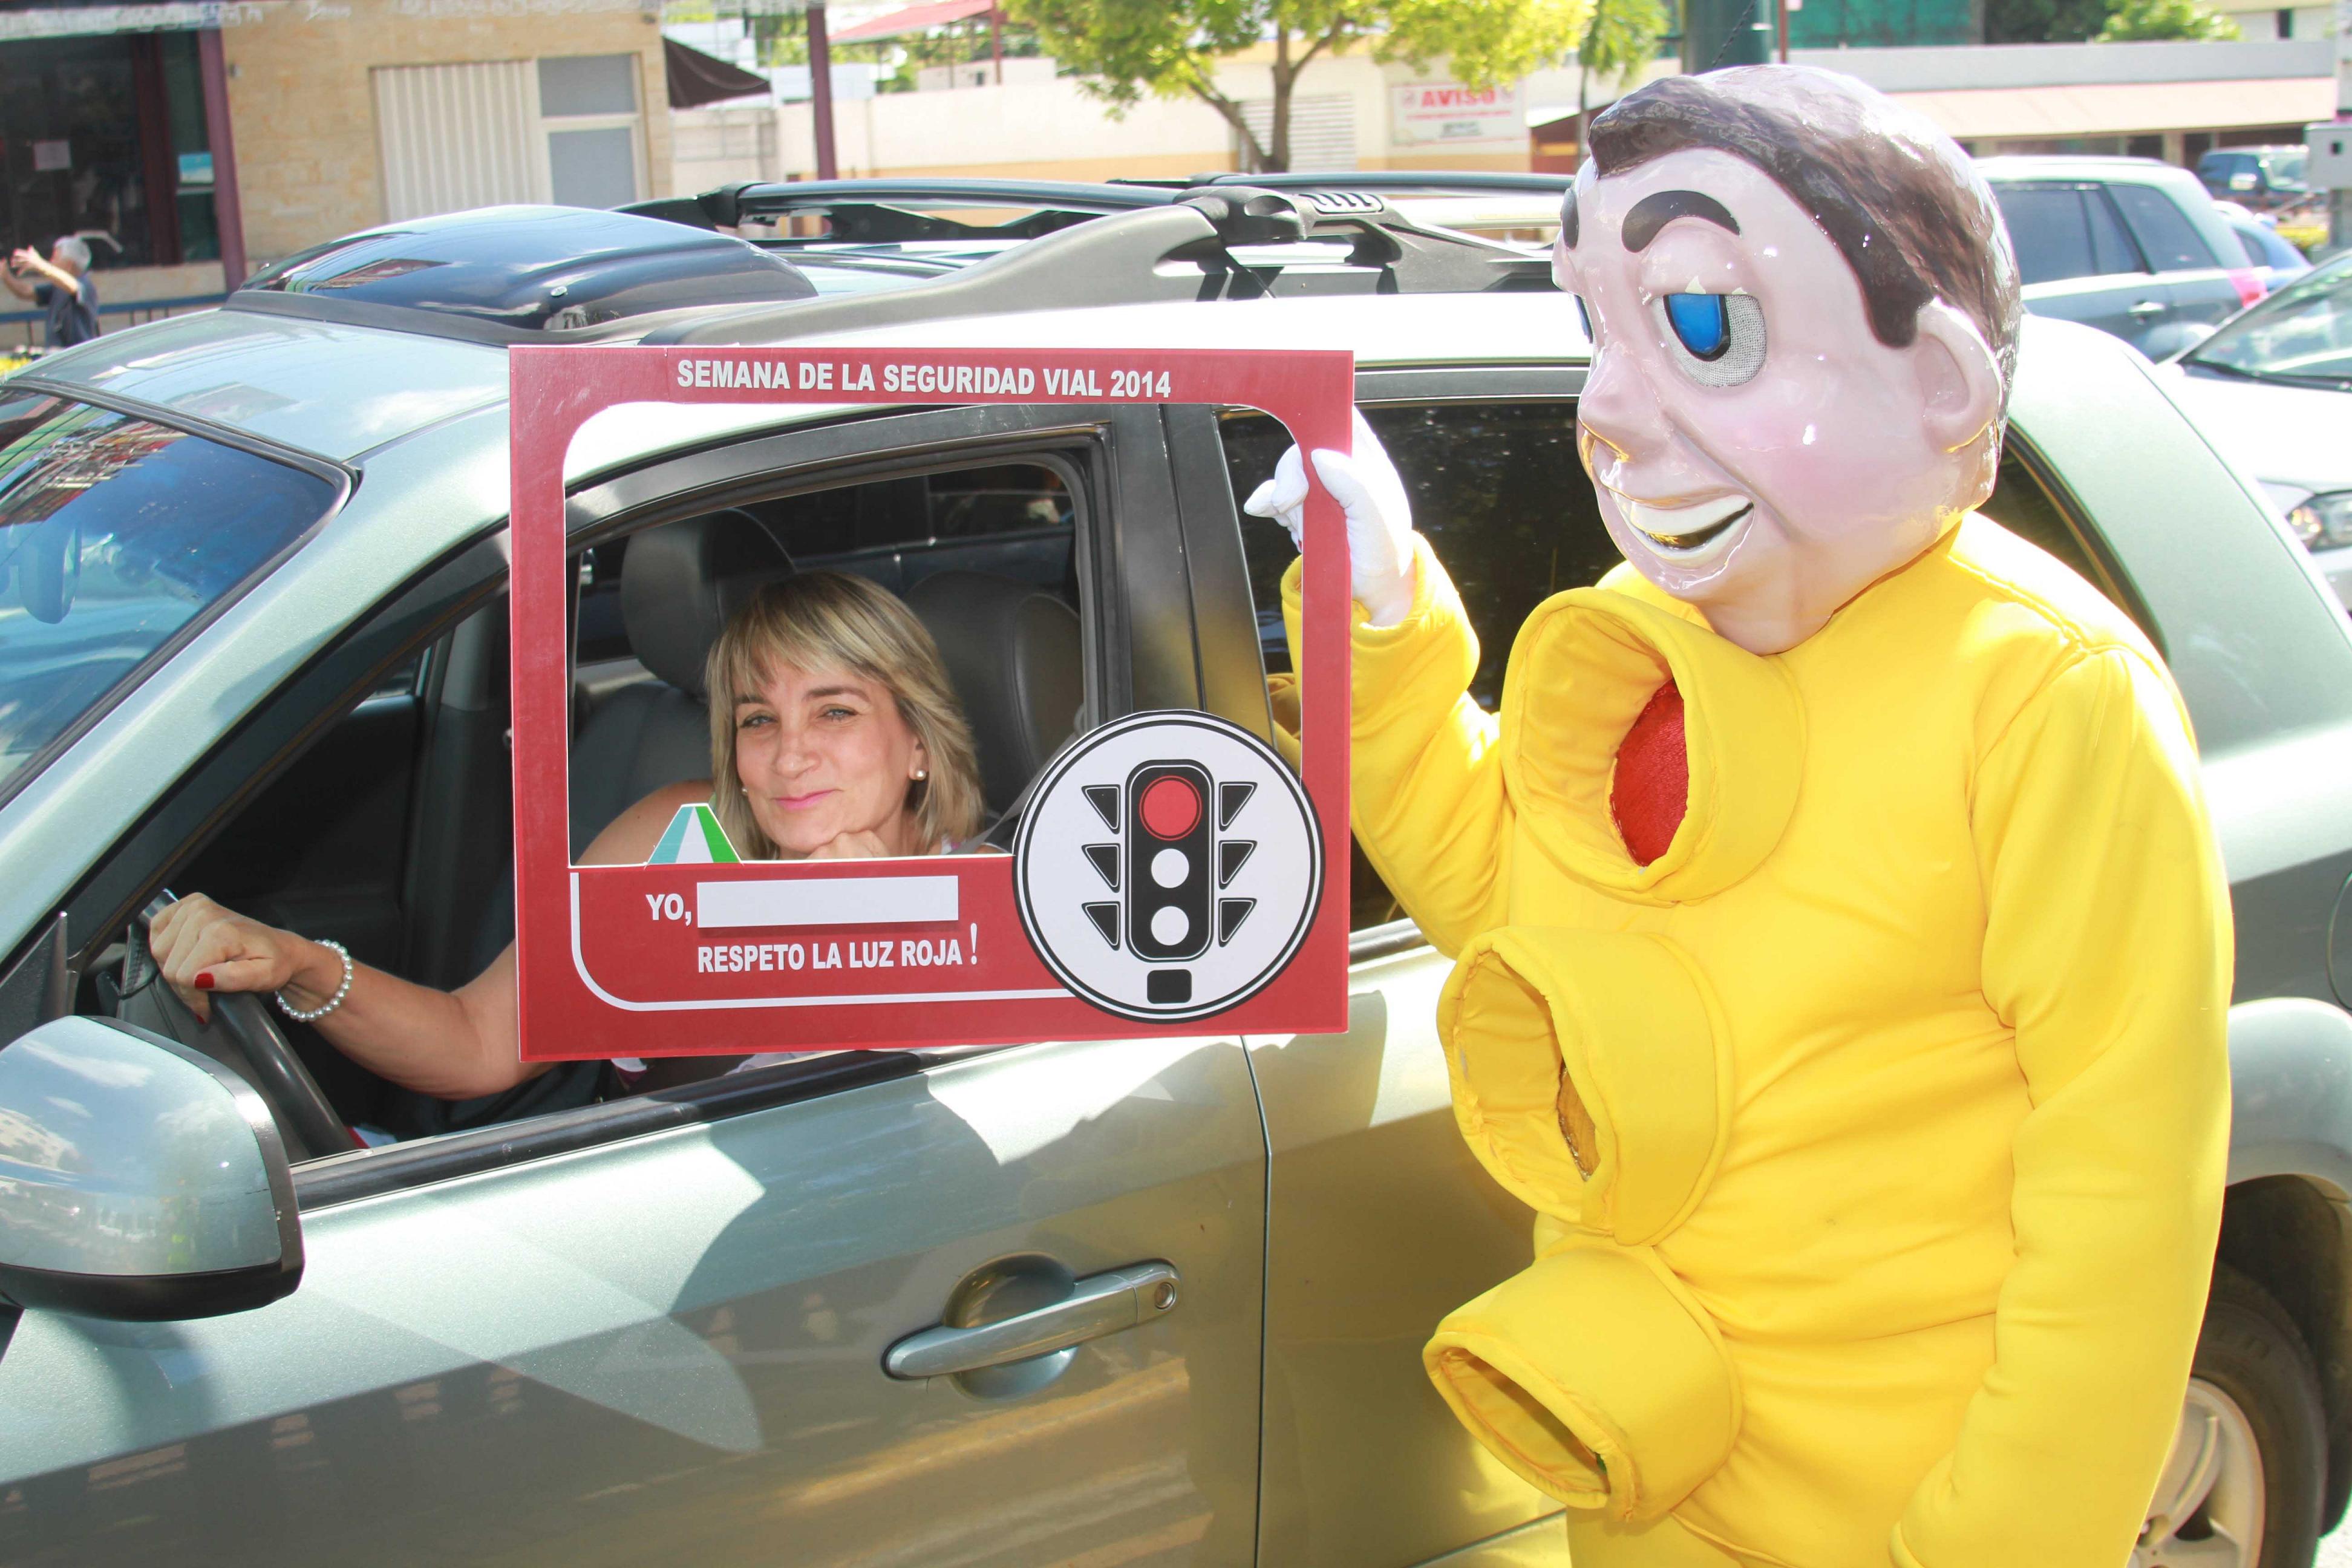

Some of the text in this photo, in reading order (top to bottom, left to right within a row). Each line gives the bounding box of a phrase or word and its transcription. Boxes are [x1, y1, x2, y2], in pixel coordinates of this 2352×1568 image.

[677, 359, 1171, 398] SEMANA DE LA SEGURIDAD VIAL 2014
[645, 893, 692, 926] YO,
[698, 942, 805, 973] RESPETO
[812, 942, 843, 969] LA
[849, 941, 894, 969] LUZ
[901, 939, 963, 967] ROJA
